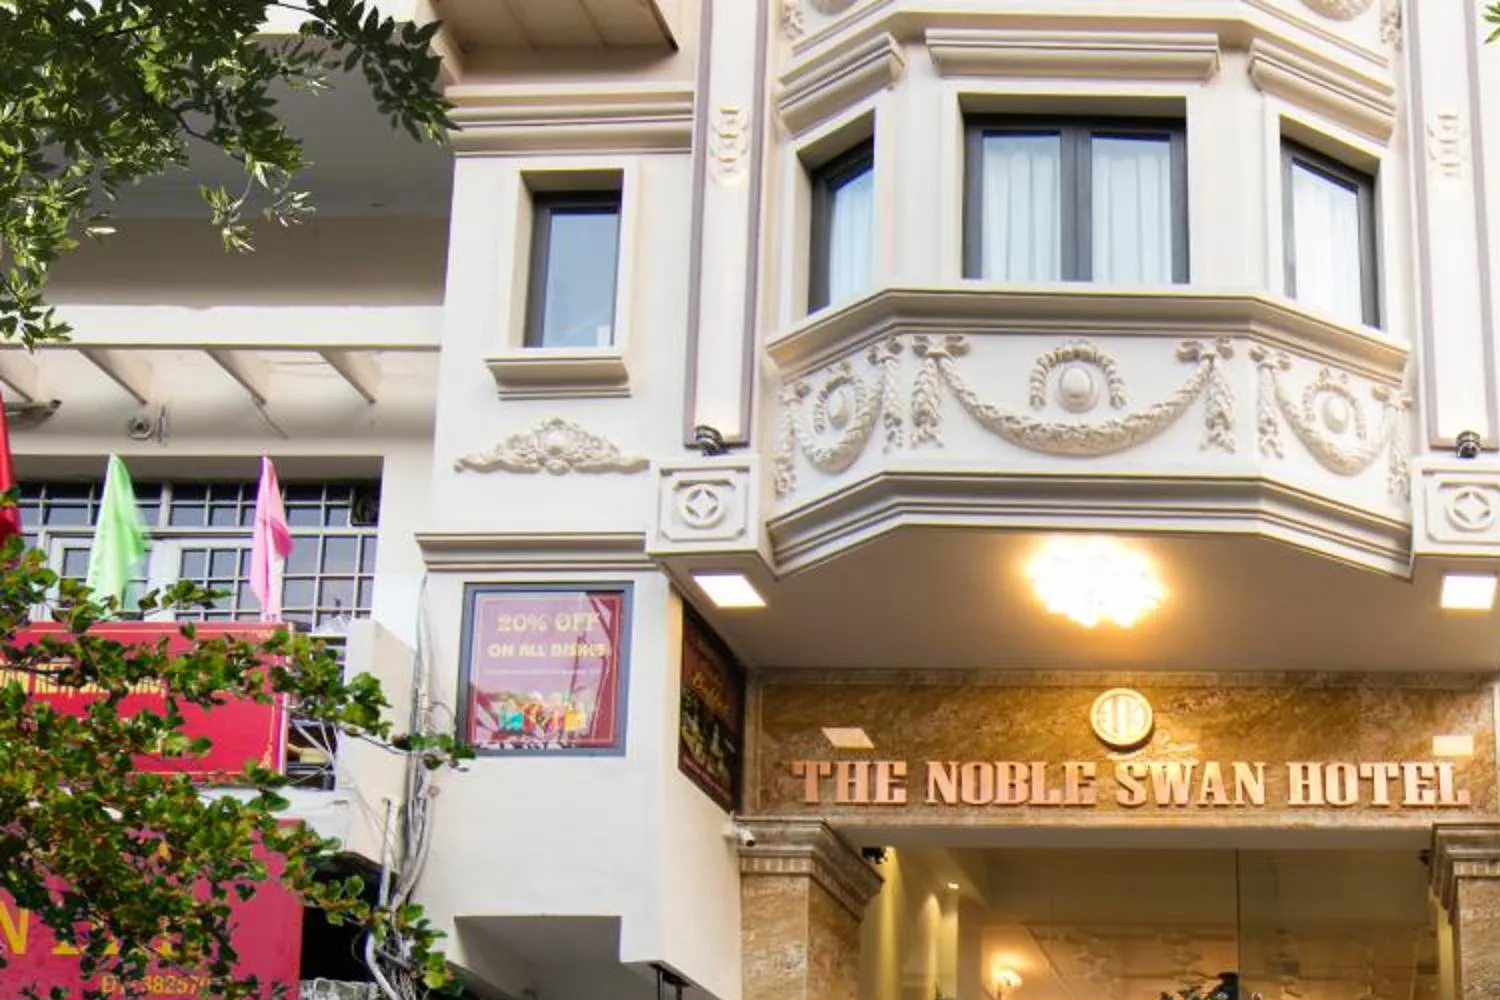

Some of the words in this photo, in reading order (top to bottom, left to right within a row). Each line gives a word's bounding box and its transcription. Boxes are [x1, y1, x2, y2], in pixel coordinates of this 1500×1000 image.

[497, 613, 547, 632] 20%
[555, 613, 599, 632] OFF
[488, 643, 514, 658] ON
[518, 643, 546, 658] ALL
[791, 760, 907, 805] THE
[924, 760, 1097, 806] NOBLE
[1113, 760, 1267, 807] SWAN
[1286, 760, 1472, 808] HOTEL
